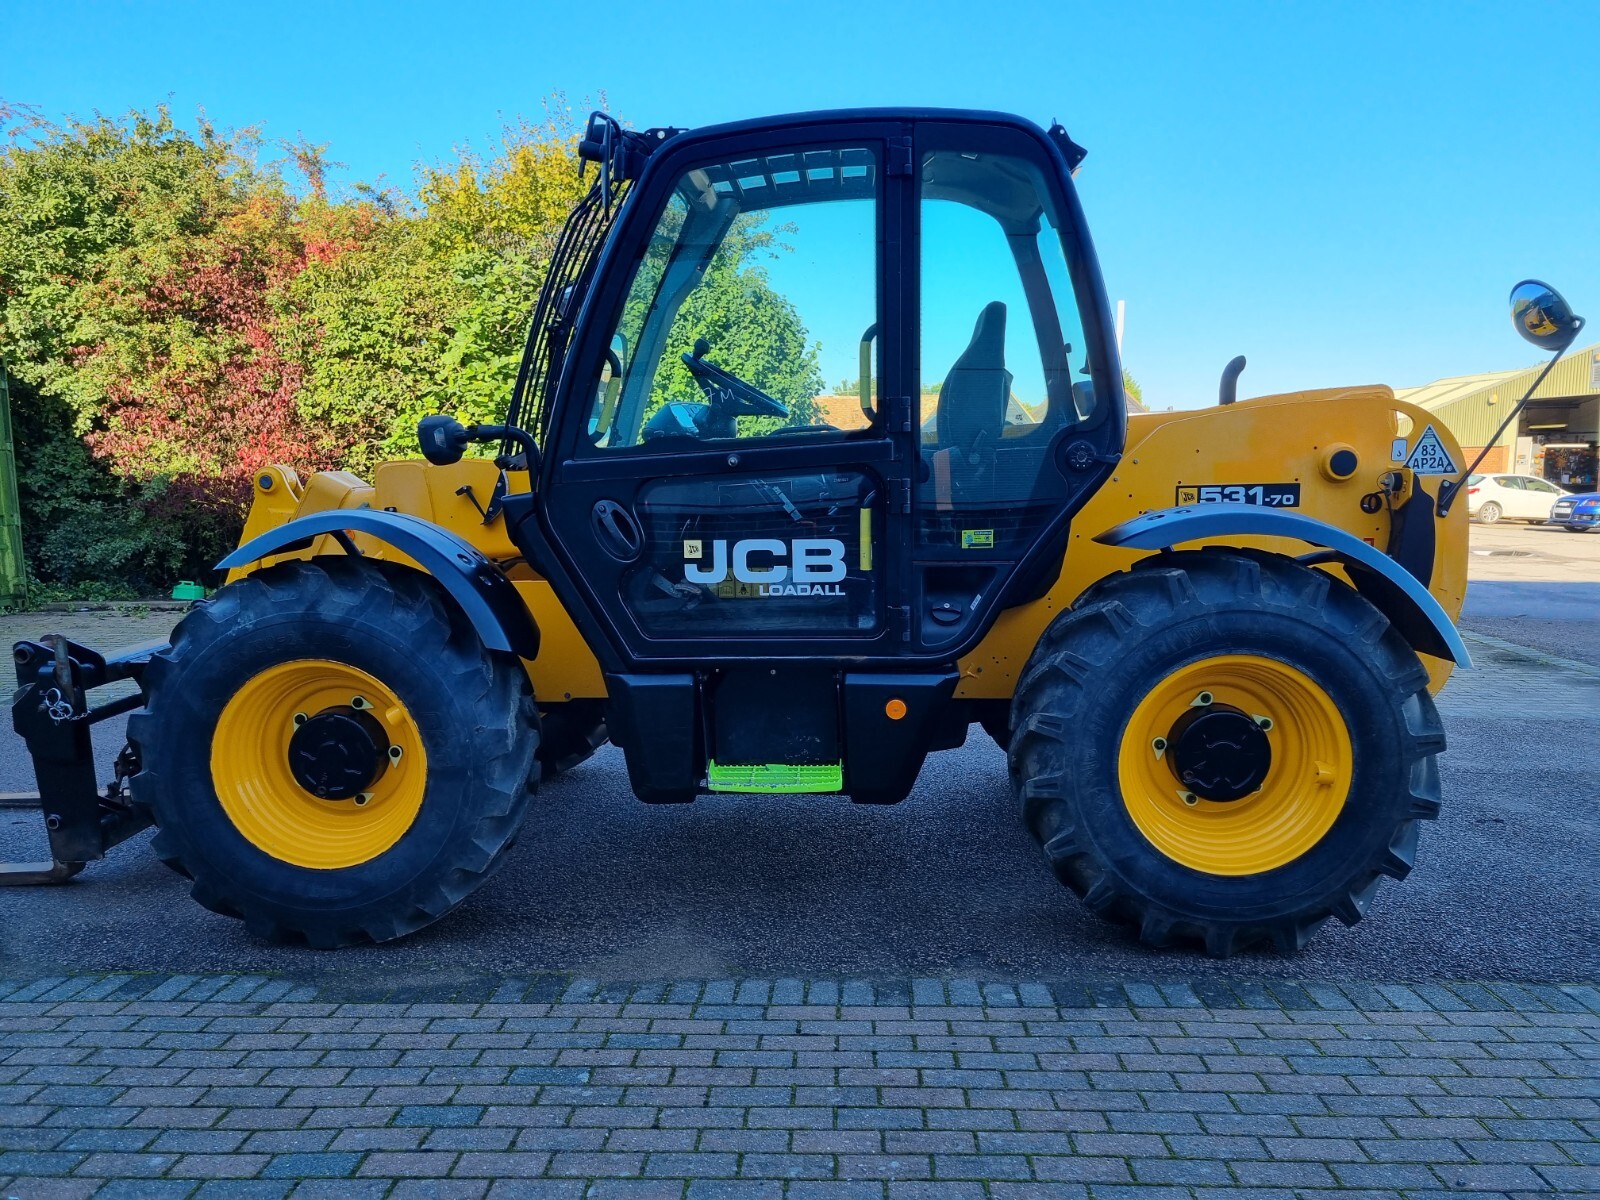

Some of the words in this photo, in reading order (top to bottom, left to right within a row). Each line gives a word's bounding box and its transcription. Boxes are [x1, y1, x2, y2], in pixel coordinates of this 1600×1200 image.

[1421, 445, 1437, 457] 83
[1412, 456, 1445, 470] AP2A
[1200, 486, 1295, 506] 531-70
[684, 539, 847, 584] JCB
[759, 584, 846, 596] LOADALL
